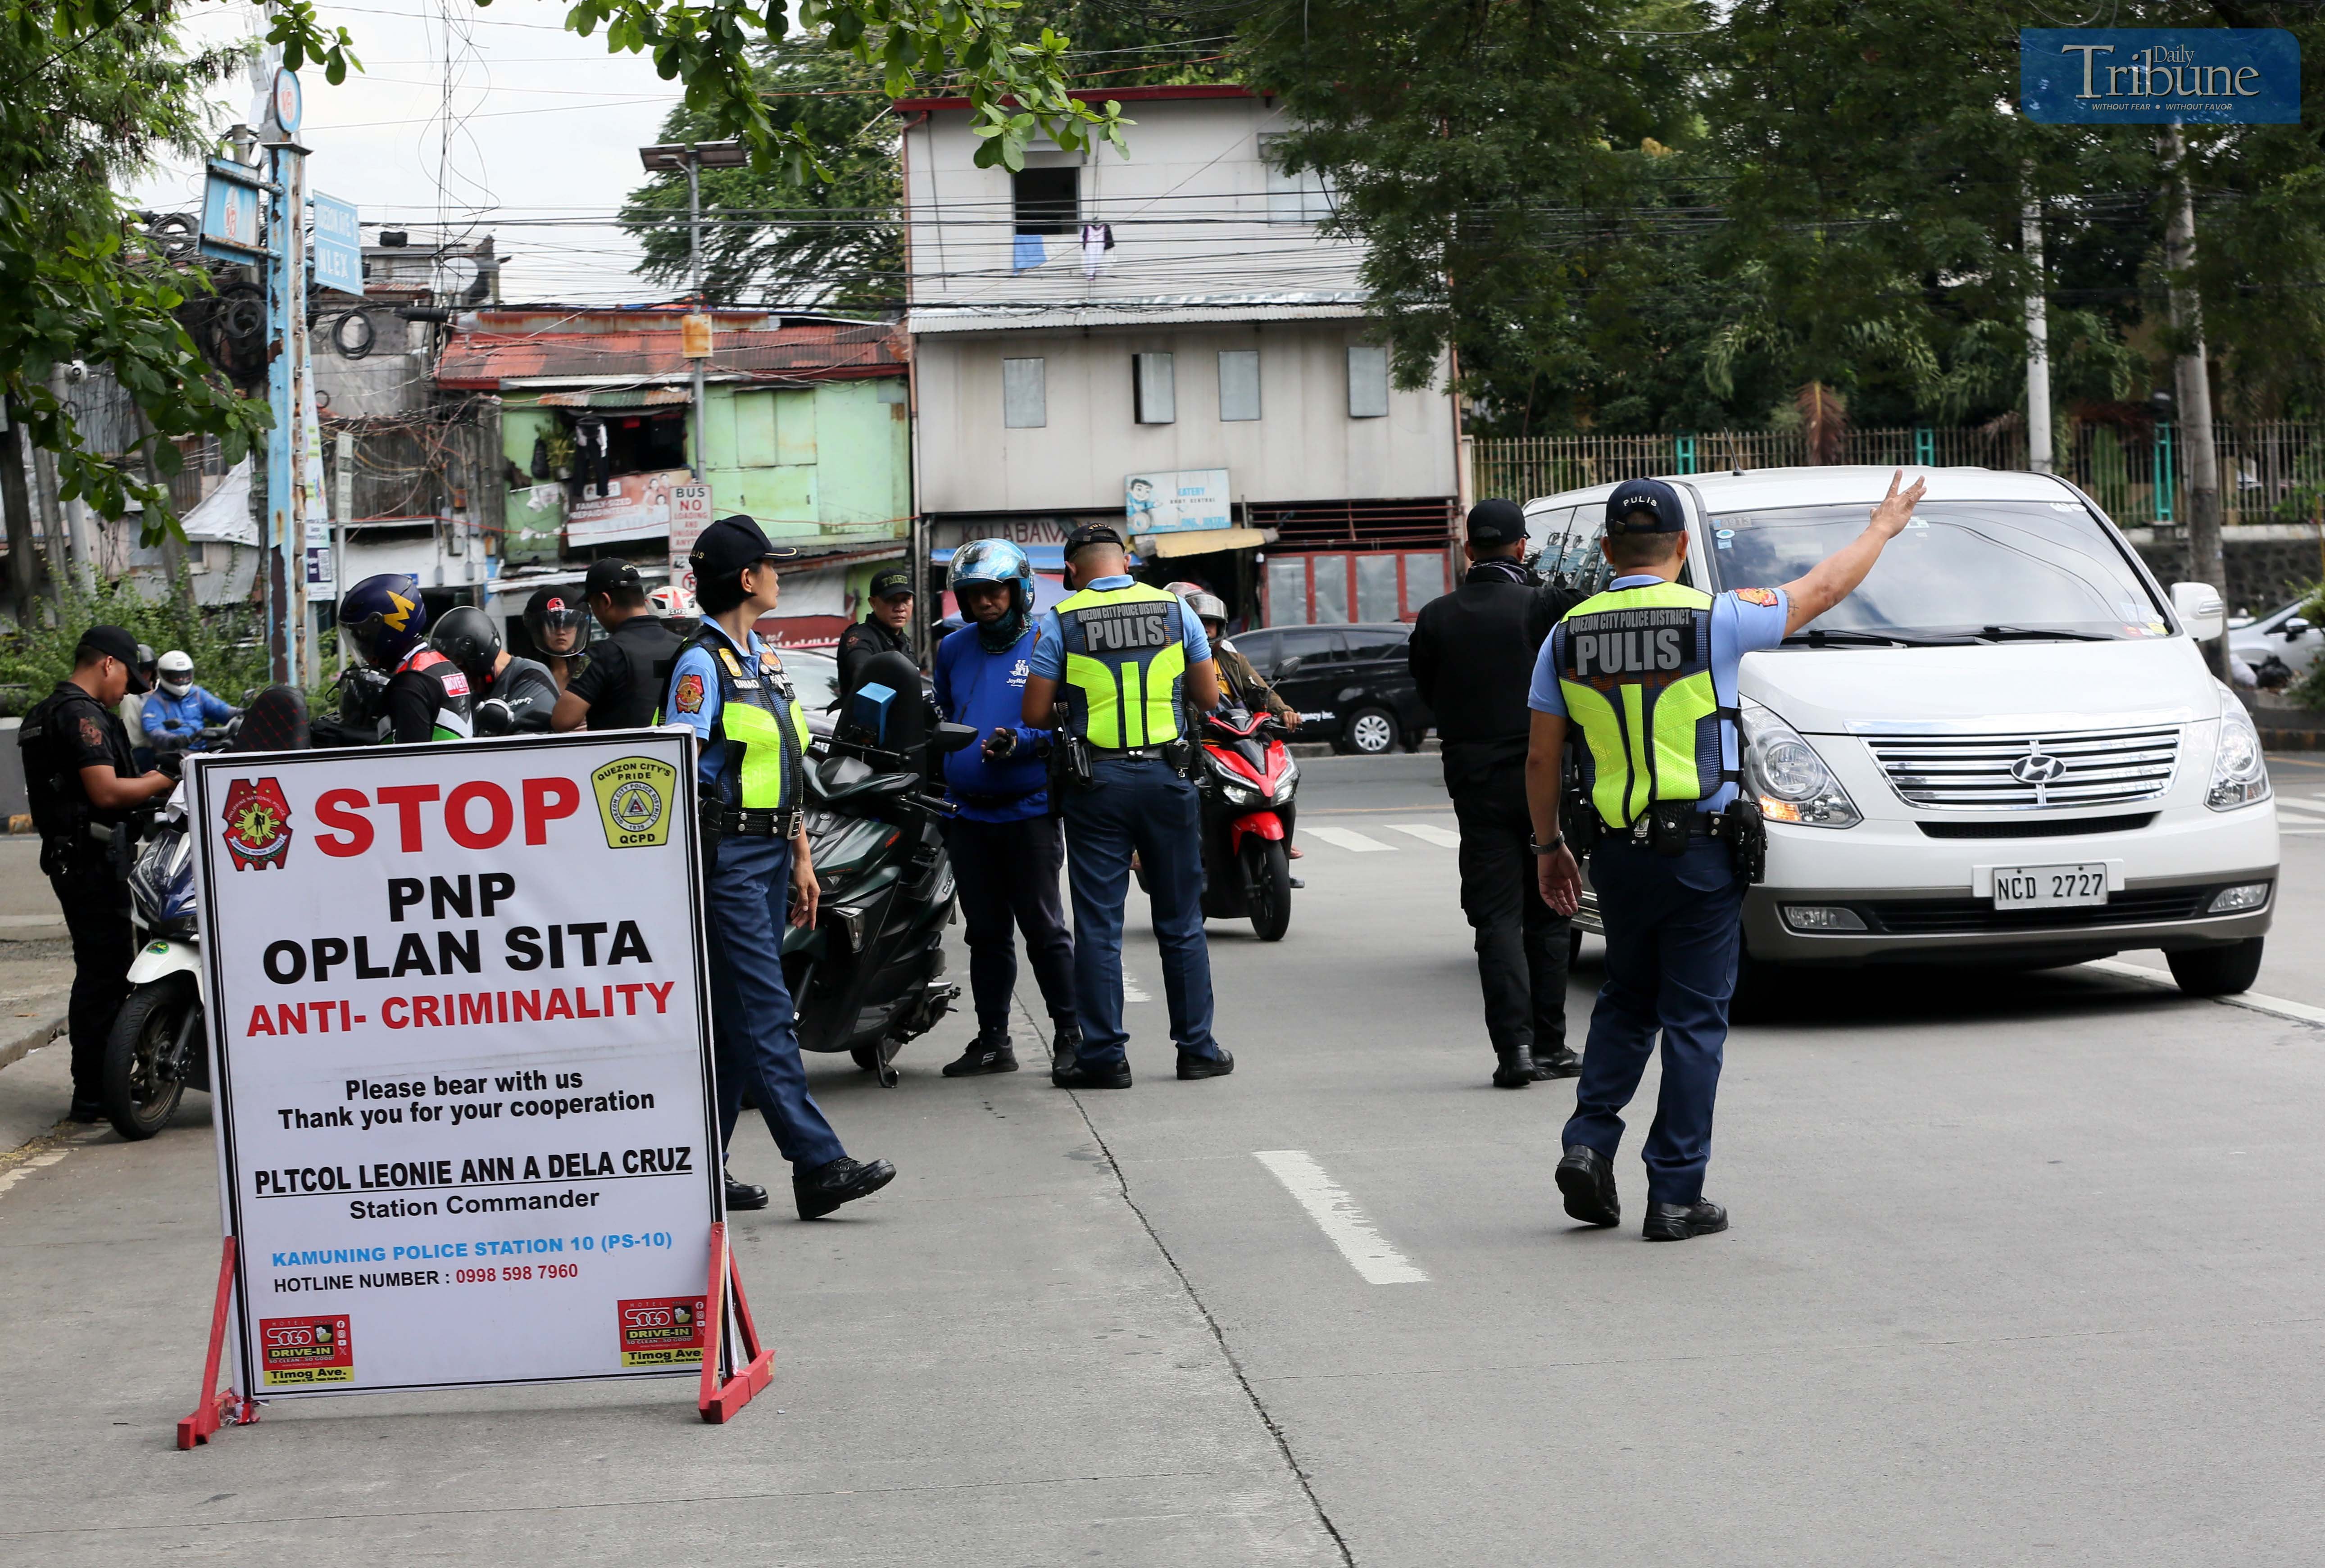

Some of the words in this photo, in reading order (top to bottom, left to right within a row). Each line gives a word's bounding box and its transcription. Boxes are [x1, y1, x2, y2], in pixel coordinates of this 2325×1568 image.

[319, 248, 349, 279] NLEX
[676, 488, 705, 498] BUS
[1623, 496, 1657, 507] PULIS
[679, 500, 702, 511] NO
[1077, 608, 1102, 622] QUEZON
[1102, 606, 1117, 618] CITY
[1117, 604, 1138, 617] POLICE
[1138, 602, 1167, 615] DISTRICT
[1570, 616, 1598, 634] QUEZON
[1600, 613, 1619, 630] CITY
[1621, 611, 1648, 628] POLICE
[1650, 609, 1690, 626] DISTRICT
[1085, 616, 1165, 651] PULIS
[1576, 629, 1681, 675] PULIS
[733, 679, 759, 689] DANAO
[1298, 711, 1321, 722] gency
[598, 763, 636, 780] QUEZON
[640, 763, 671, 777] CITY'S
[617, 786, 628, 798] CITY
[630, 784, 653, 794] POLICE
[227, 799, 246, 820] PHILIPPINE
[272, 802, 286, 816] POLICE
[314, 777, 580, 857] STOP
[612, 799, 623, 824] QUEZON
[650, 794, 659, 823] DISTRICT
[620, 834, 655, 844] QCPD
[387, 872, 516, 922] PNP
[1997, 876, 2036, 901] NCD
[2052, 873, 2103, 897] 2727
[263, 929, 481, 984] OPLAN
[505, 920, 653, 971] SITA
[247, 1000, 366, 1037] ANTI-
[381, 981, 675, 1029] CRIMINALITY
[345, 1079, 427, 1101] Please
[433, 1075, 488, 1096] bear
[495, 1070, 548, 1092] with
[555, 1072, 583, 1089] us
[278, 1106, 354, 1129] Thank
[360, 1108, 403, 1131] you
[409, 1101, 443, 1122] for
[450, 1102, 503, 1126] your
[510, 1090, 654, 1119] cooperation
[255, 1166, 352, 1194] PLTCOL
[359, 1160, 453, 1188] LEONIE
[460, 1157, 514, 1183] ANN
[523, 1156, 541, 1180] A
[548, 1151, 615, 1178] DELA
[622, 1147, 692, 1174] CRUZ
[350, 1198, 438, 1219] Station
[446, 1189, 600, 1214] Commander
[272, 1246, 386, 1267] KAMUNING
[393, 1243, 468, 1260] POLICE
[475, 1238, 563, 1256] STATION
[571, 1236, 594, 1251] 10
[601, 1232, 672, 1253] (PS-10)
[274, 1275, 354, 1293] HOTLINE
[359, 1270, 440, 1288] NUMBER
[456, 1268, 496, 1283] 0998
[502, 1266, 532, 1281] 598
[537, 1263, 578, 1279] 7960
[625, 1307, 670, 1328] SOGO
[267, 1326, 311, 1346] SOGO
[629, 1328, 689, 1338] DRIVE-IN
[272, 1347, 331, 1357] DRIVE-IN
[629, 1352, 671, 1360] Timog
[271, 1371, 313, 1379] Timog
[317, 1369, 346, 1377] Ave.
